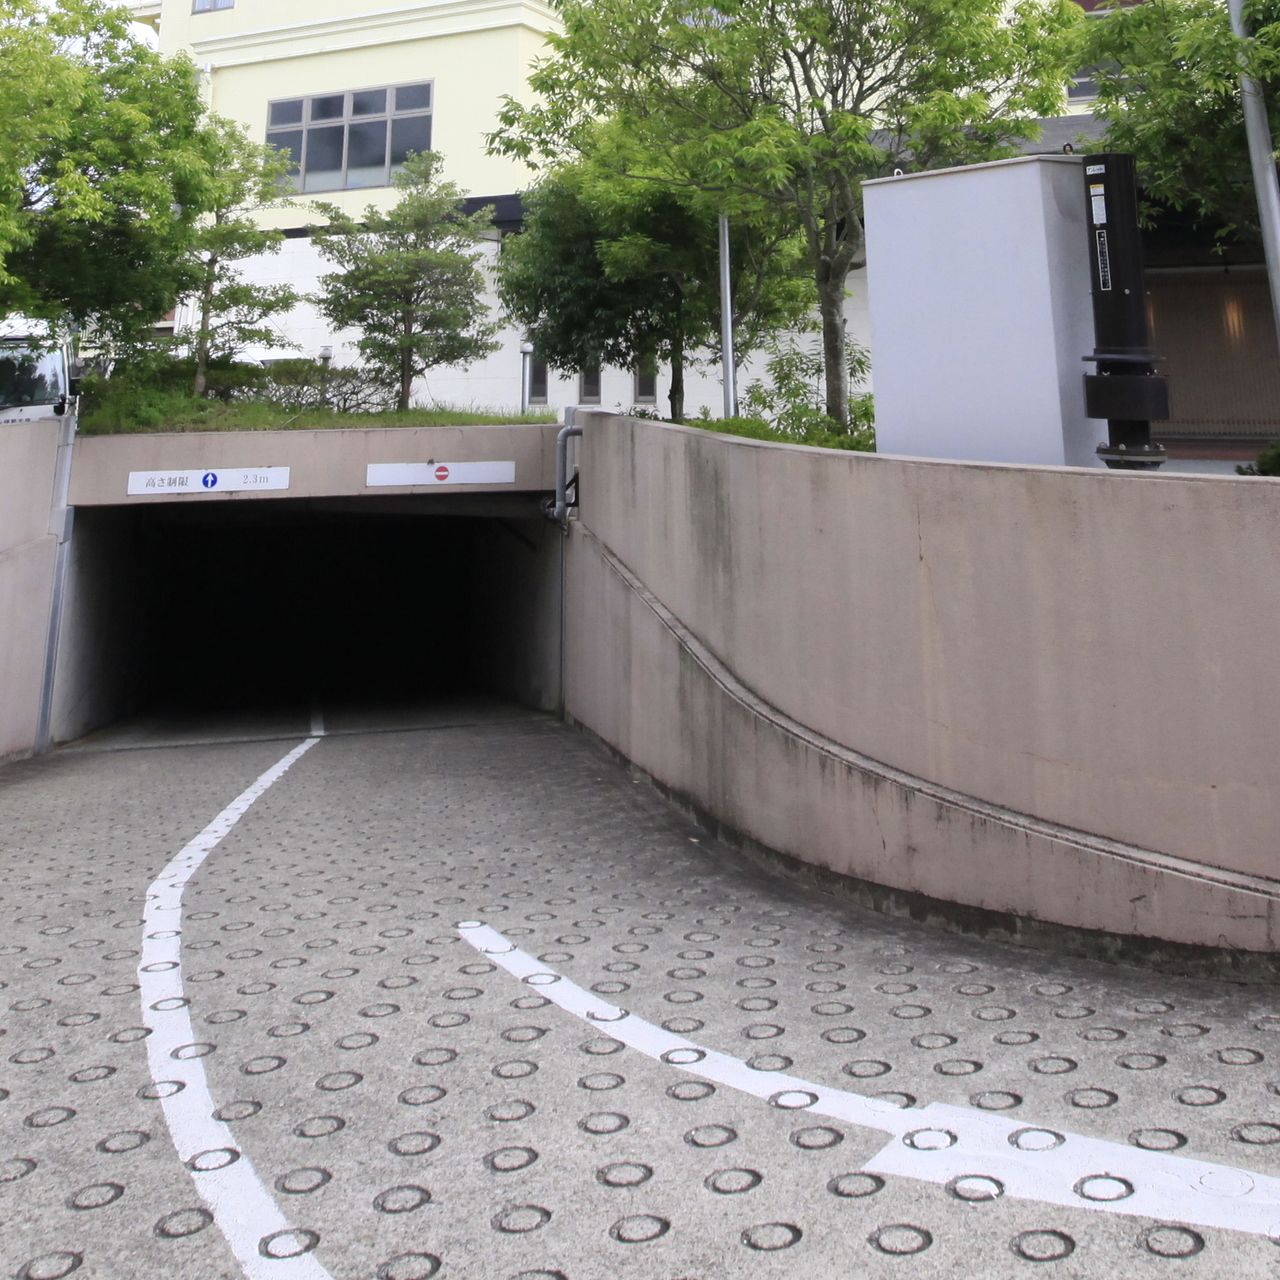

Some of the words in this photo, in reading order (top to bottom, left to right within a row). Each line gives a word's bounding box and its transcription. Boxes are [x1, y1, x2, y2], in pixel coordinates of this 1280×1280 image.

[145, 476, 189, 488] 高さ制限
[242, 474, 269, 485] 2.3m
